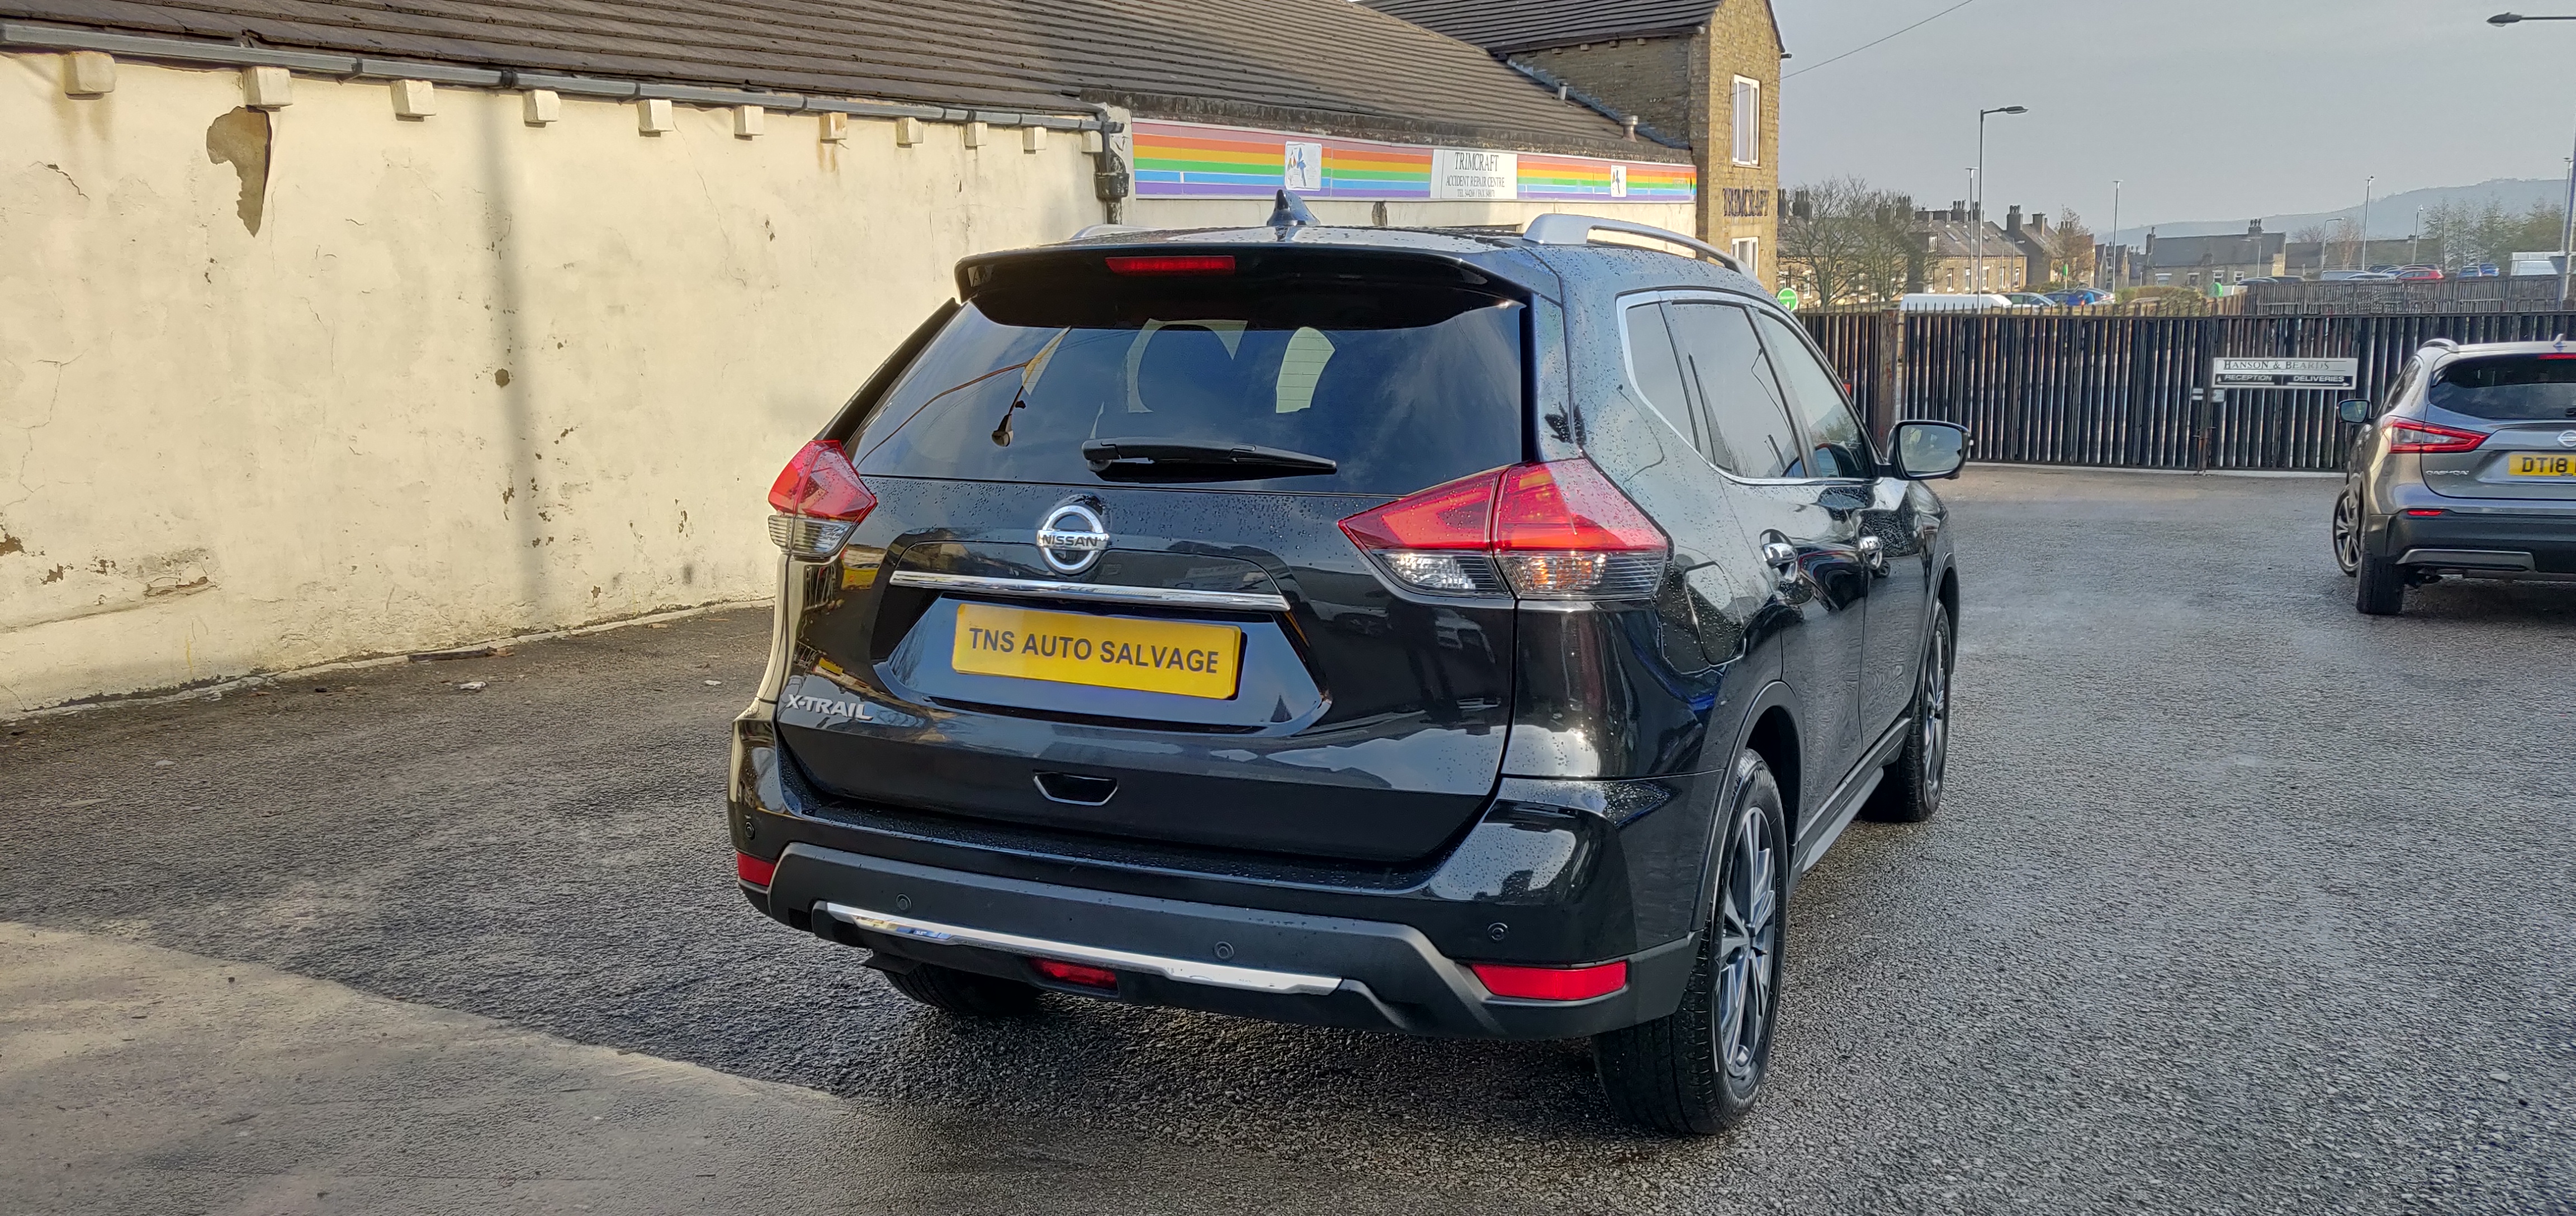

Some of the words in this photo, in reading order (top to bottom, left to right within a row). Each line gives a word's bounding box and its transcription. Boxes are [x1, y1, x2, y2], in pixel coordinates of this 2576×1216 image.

[1455, 152, 1499, 172] TRIMCRAFT
[1446, 175, 1470, 187] ACCIDENT
[1470, 176, 1487, 187] REPAIR
[1487, 177, 1505, 188] CENTRE
[2224, 360, 2268, 369] HANSON
[2522, 457, 2568, 473] DT18
[1043, 535, 1097, 547] NISSAN
[969, 628, 1015, 653] TNS
[1022, 634, 1092, 660] AUTO
[1100, 640, 1219, 673] SALVAGE
[786, 694, 873, 721] X-TRAIL
